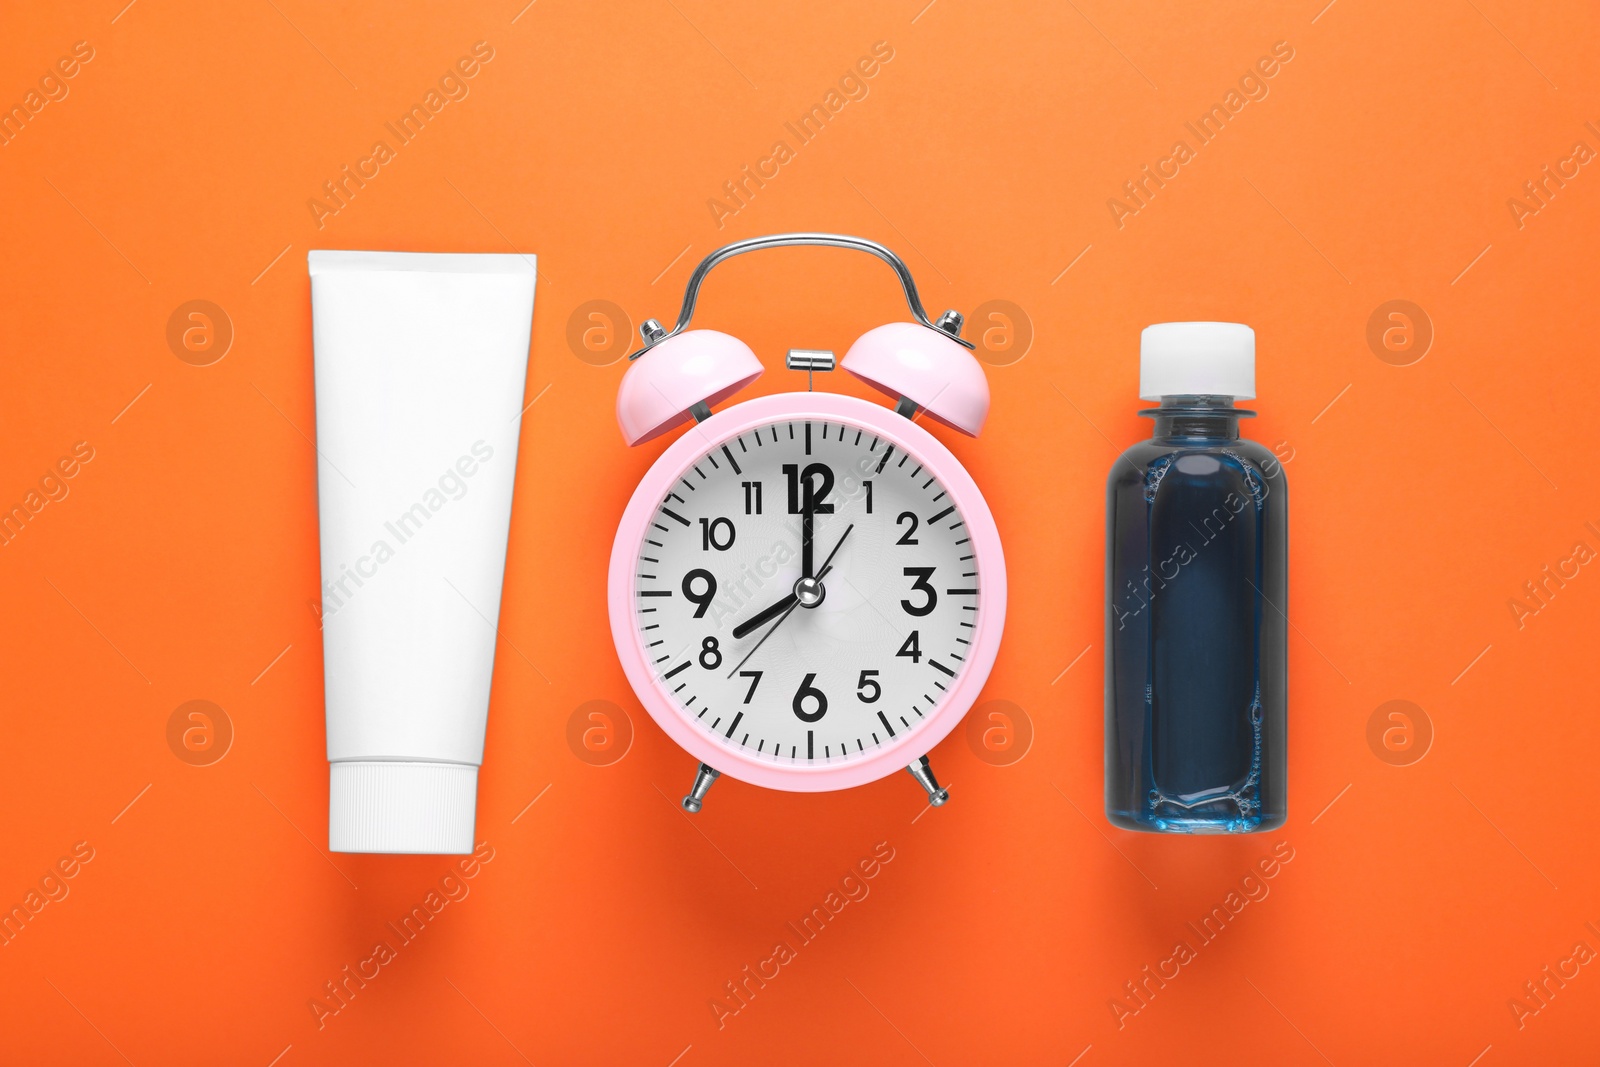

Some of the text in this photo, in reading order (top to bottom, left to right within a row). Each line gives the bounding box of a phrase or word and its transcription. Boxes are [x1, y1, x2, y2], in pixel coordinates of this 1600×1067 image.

[742, 482, 762, 514] 11
[782, 463, 834, 516] 12
[863, 481, 872, 513] 1
[699, 517, 735, 551] 10
[896, 512, 918, 545] 2
[682, 569, 717, 618] 9
[901, 567, 937, 616] 3
[699, 636, 722, 670] 8
[896, 631, 921, 663] 4
[740, 671, 763, 703] 7
[793, 674, 827, 722] 6
[857, 670, 881, 703] 5
